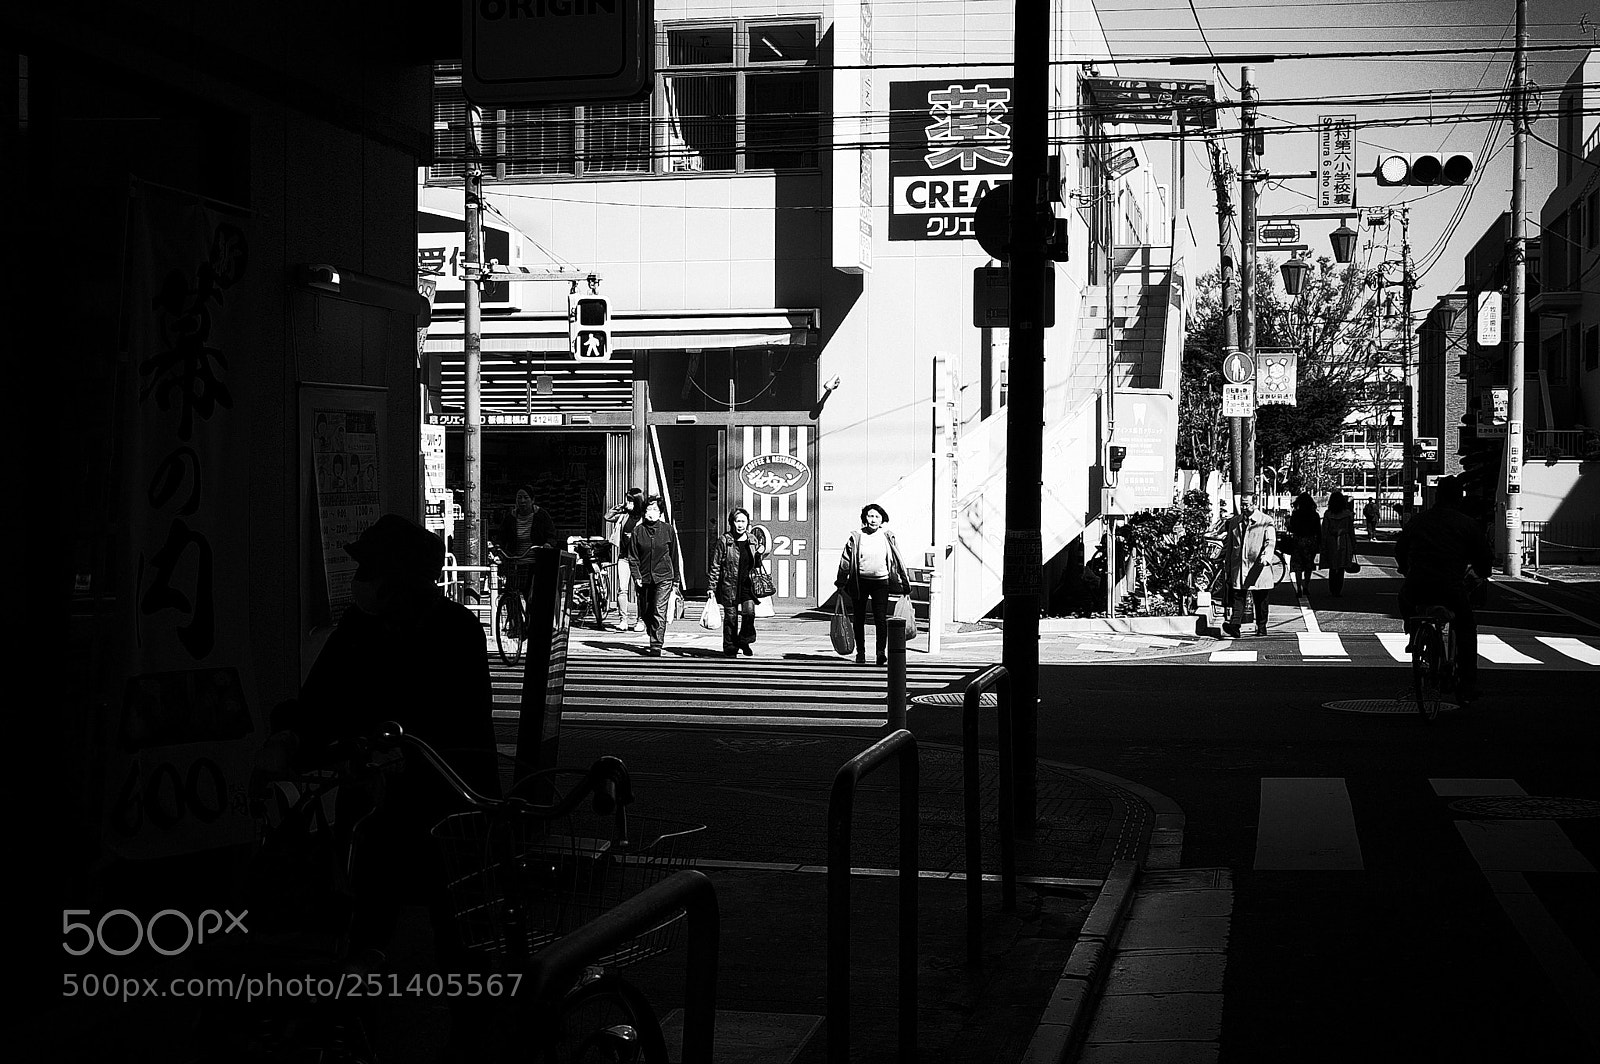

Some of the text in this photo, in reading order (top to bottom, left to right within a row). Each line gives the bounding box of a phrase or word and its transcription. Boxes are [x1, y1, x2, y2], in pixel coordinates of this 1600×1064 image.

[480, 0, 616, 20] ORIGIN
[923, 84, 1013, 171] 薬
[906, 180, 1013, 209] CREA
[744, 457, 765, 472] COFFEE
[773, 535, 807, 556] 2F
